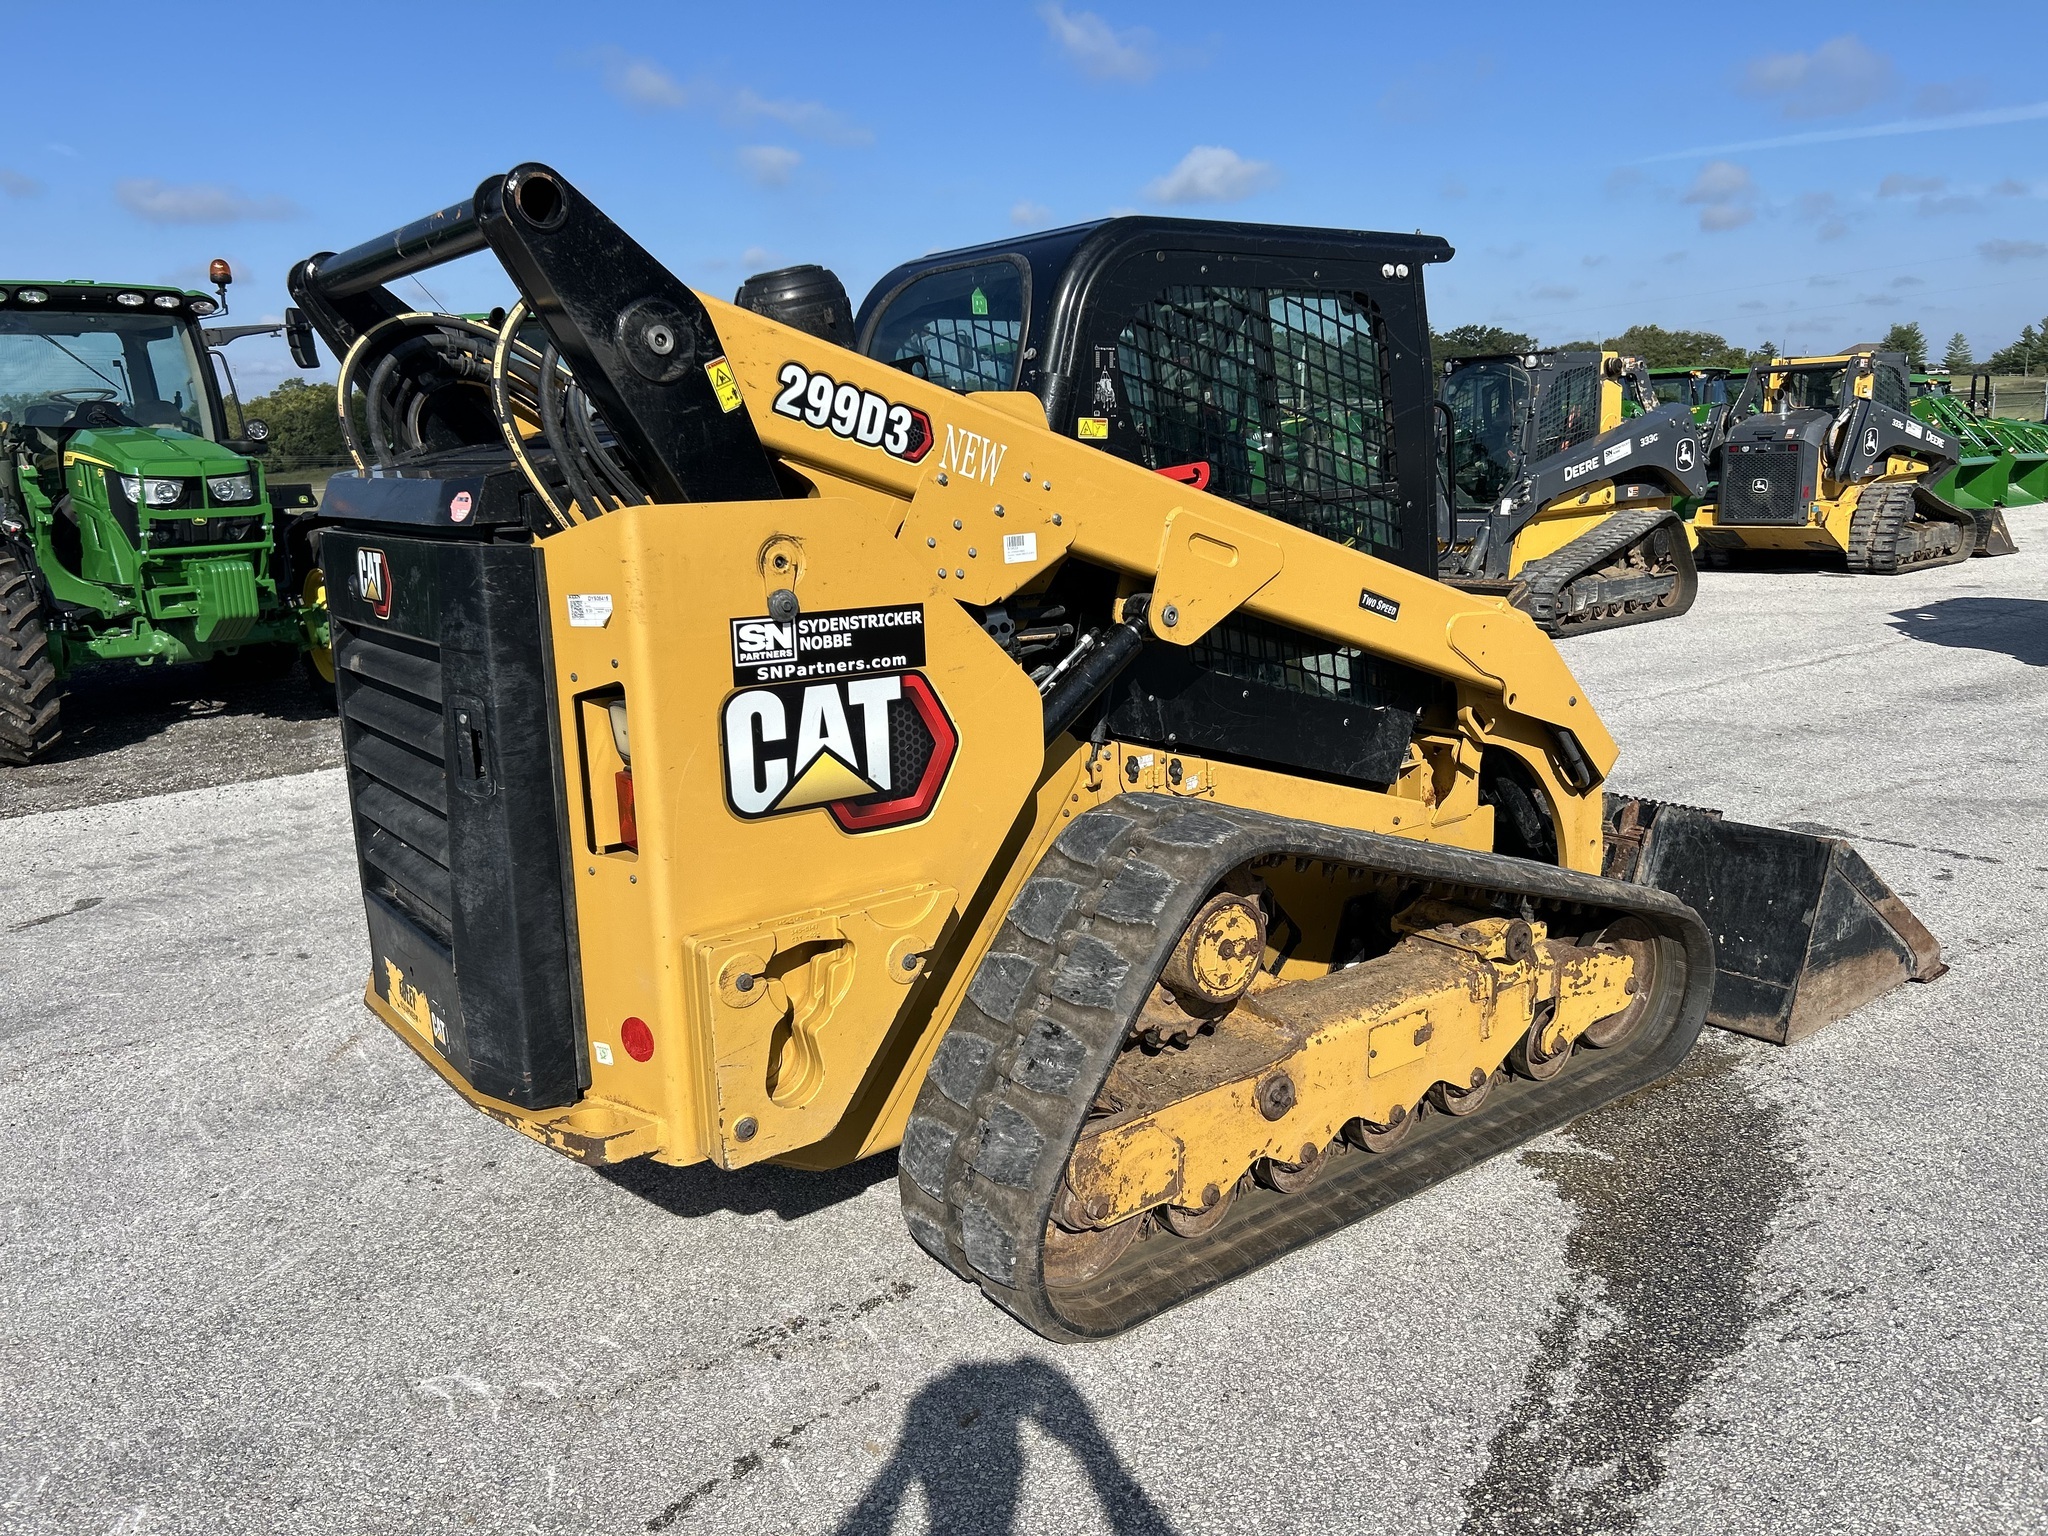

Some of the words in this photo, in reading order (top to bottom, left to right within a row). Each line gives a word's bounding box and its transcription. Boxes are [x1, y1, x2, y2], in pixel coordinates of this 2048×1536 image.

[775, 363, 912, 454] 299D3
[938, 423, 1007, 486] NEW
[1639, 433, 1659, 448] 333G
[1925, 429, 1946, 449] DEERE
[1563, 456, 1600, 482] DEERE
[358, 549, 383, 601] CAT
[798, 610, 923, 634] SYDENSTRICKER
[799, 633, 853, 651] NOBBE
[739, 649, 793, 662] PARTNERS
[757, 654, 907, 681] SNPartners.com
[725, 675, 902, 814] CAT
